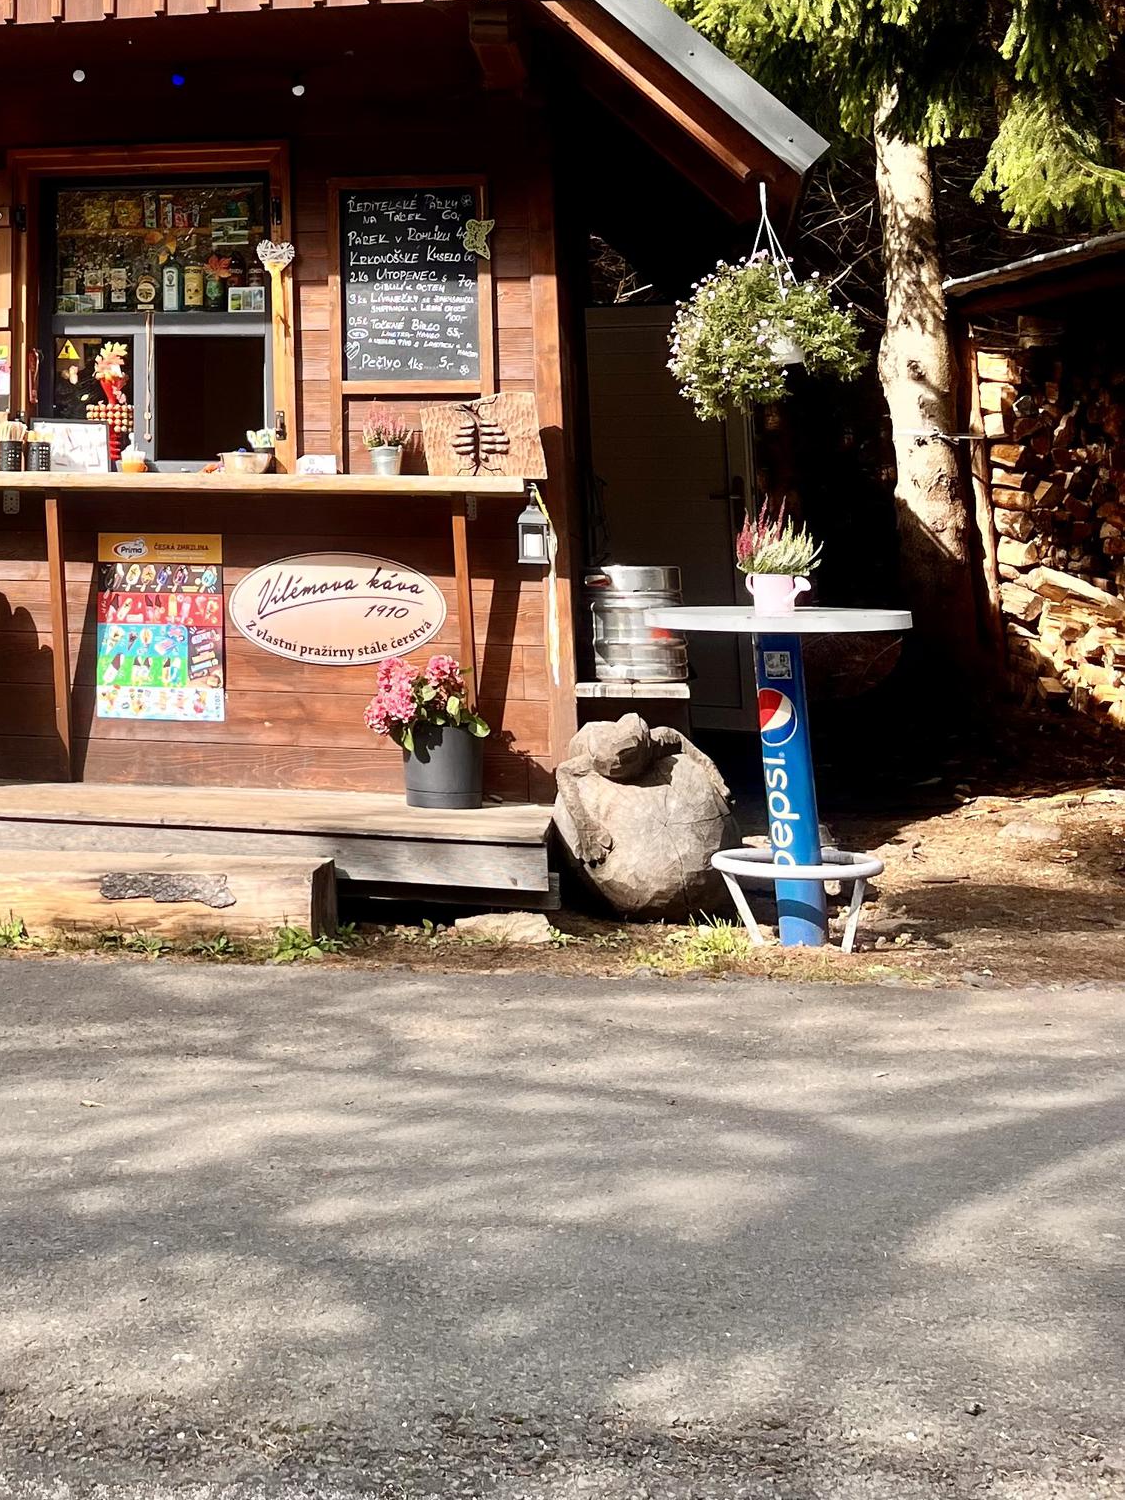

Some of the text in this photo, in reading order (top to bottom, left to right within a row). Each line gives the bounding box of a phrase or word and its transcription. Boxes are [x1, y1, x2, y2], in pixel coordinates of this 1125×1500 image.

[347, 195, 418, 213] ŘEDITELSKÉ
[363, 215, 377, 224] NA
[347, 230, 390, 246] PÁREK
[349, 245, 419, 267] KRKONOŠSKÉ
[376, 268, 438, 281] UTOPENEC
[370, 316, 405, 329] TOČENÉ
[120, 546, 143, 554] Prima
[257, 566, 424, 616] Vilémova káva
[364, 605, 410, 619] 1910
[257, 628, 298, 653] vlastní
[300, 645, 355, 660] pražírny
[357, 642, 388, 656] stále
[390, 619, 433, 650] čerstvá
